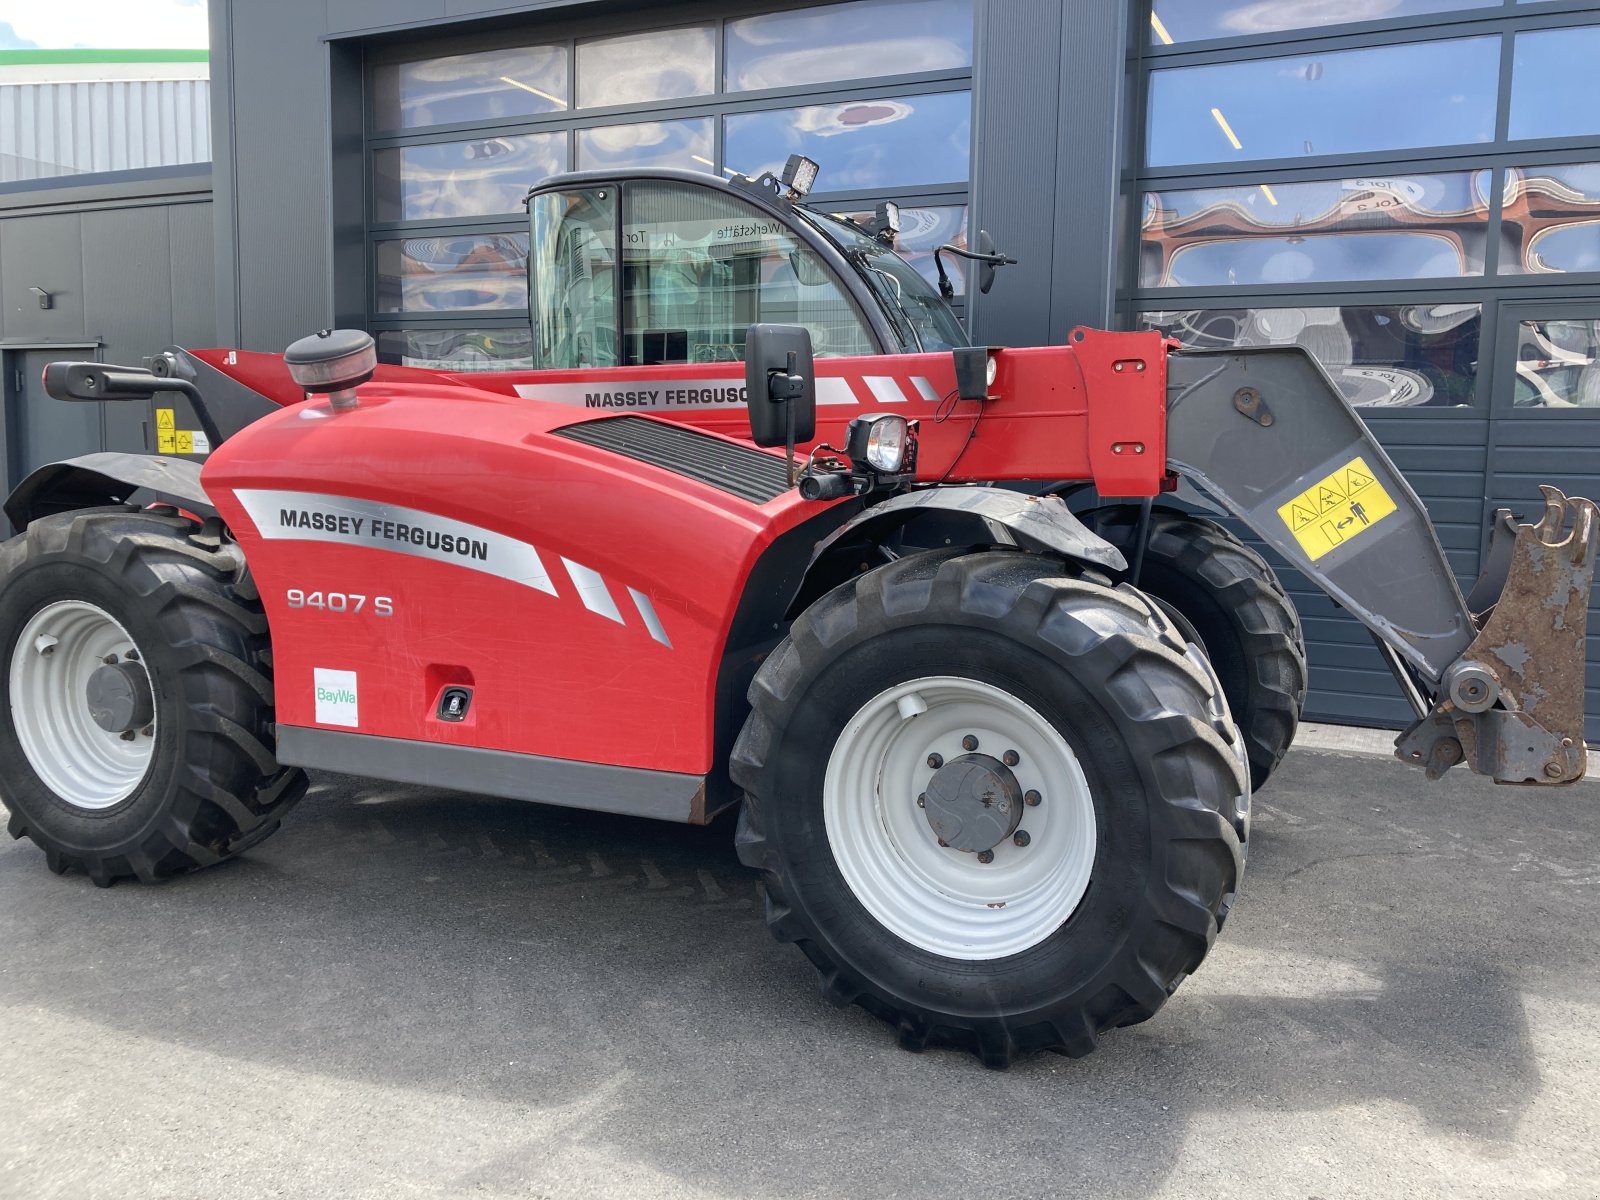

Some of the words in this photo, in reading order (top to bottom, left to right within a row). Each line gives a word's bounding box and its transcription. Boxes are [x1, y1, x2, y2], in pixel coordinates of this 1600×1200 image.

[585, 391, 660, 408] MASSEY
[665, 387, 749, 404] FERGUSO
[280, 509, 364, 535] MASSEY
[371, 520, 488, 561] FERGUSON
[287, 589, 366, 614] 9407
[374, 596, 394, 617] S
[317, 687, 356, 705] BayWa
